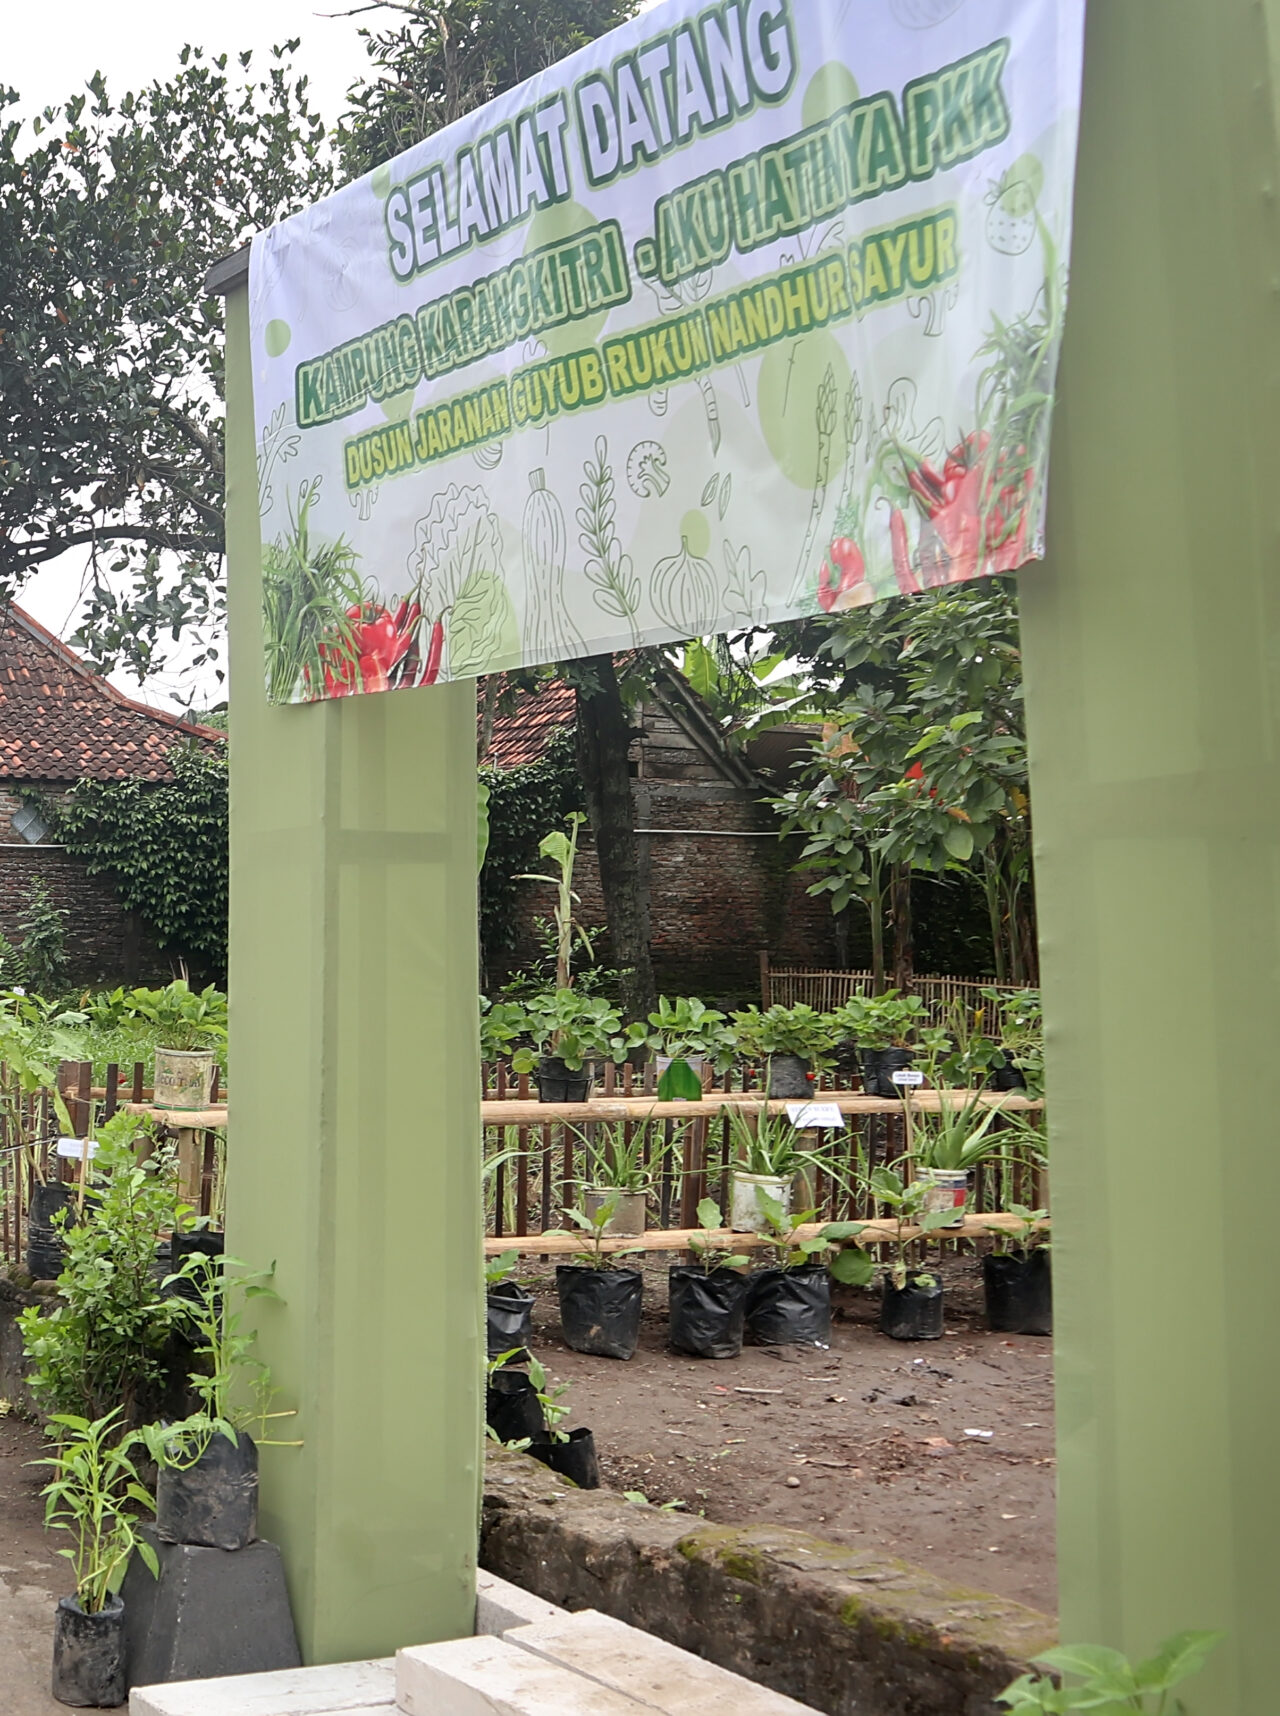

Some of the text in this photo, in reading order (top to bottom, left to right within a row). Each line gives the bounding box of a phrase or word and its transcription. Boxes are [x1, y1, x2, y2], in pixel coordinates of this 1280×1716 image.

[299, 317, 419, 425] KAMPUNG
[419, 225, 629, 378] KARANGKITRI
[730, 95, 904, 248] HATINYA
[907, 43, 1007, 176] PKK
[386, 0, 795, 280] SELAMAT DATANG
[346, 214, 957, 487] DUSUN JARANAN GUYUB RUKUN NANDHUR SAYUR
